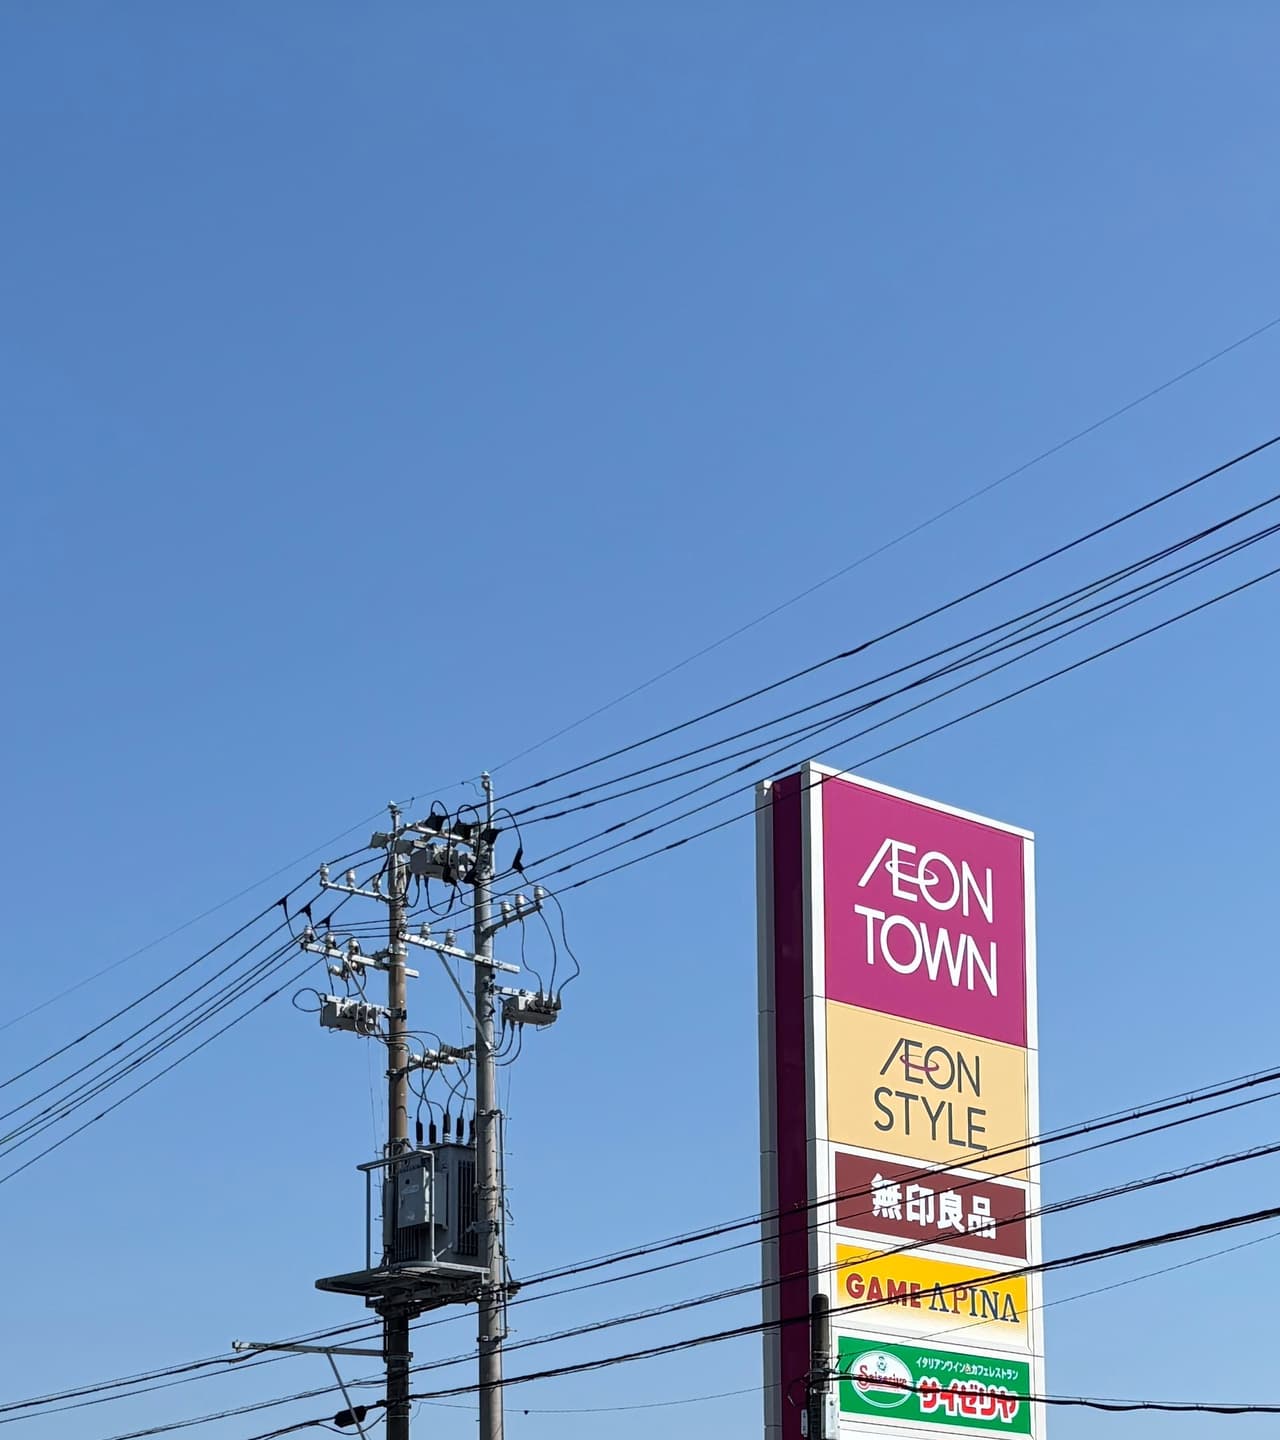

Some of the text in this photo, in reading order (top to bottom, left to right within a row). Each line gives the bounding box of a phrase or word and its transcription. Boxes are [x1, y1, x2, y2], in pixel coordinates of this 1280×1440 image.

[854, 904, 998, 998] TOWN
[873, 1086, 988, 1152] STYLE
[870, 1172, 998, 1241] 無印良品
[845, 1272, 922, 1309] GAME
[920, 1377, 1019, 1421] サイゼリヤ
